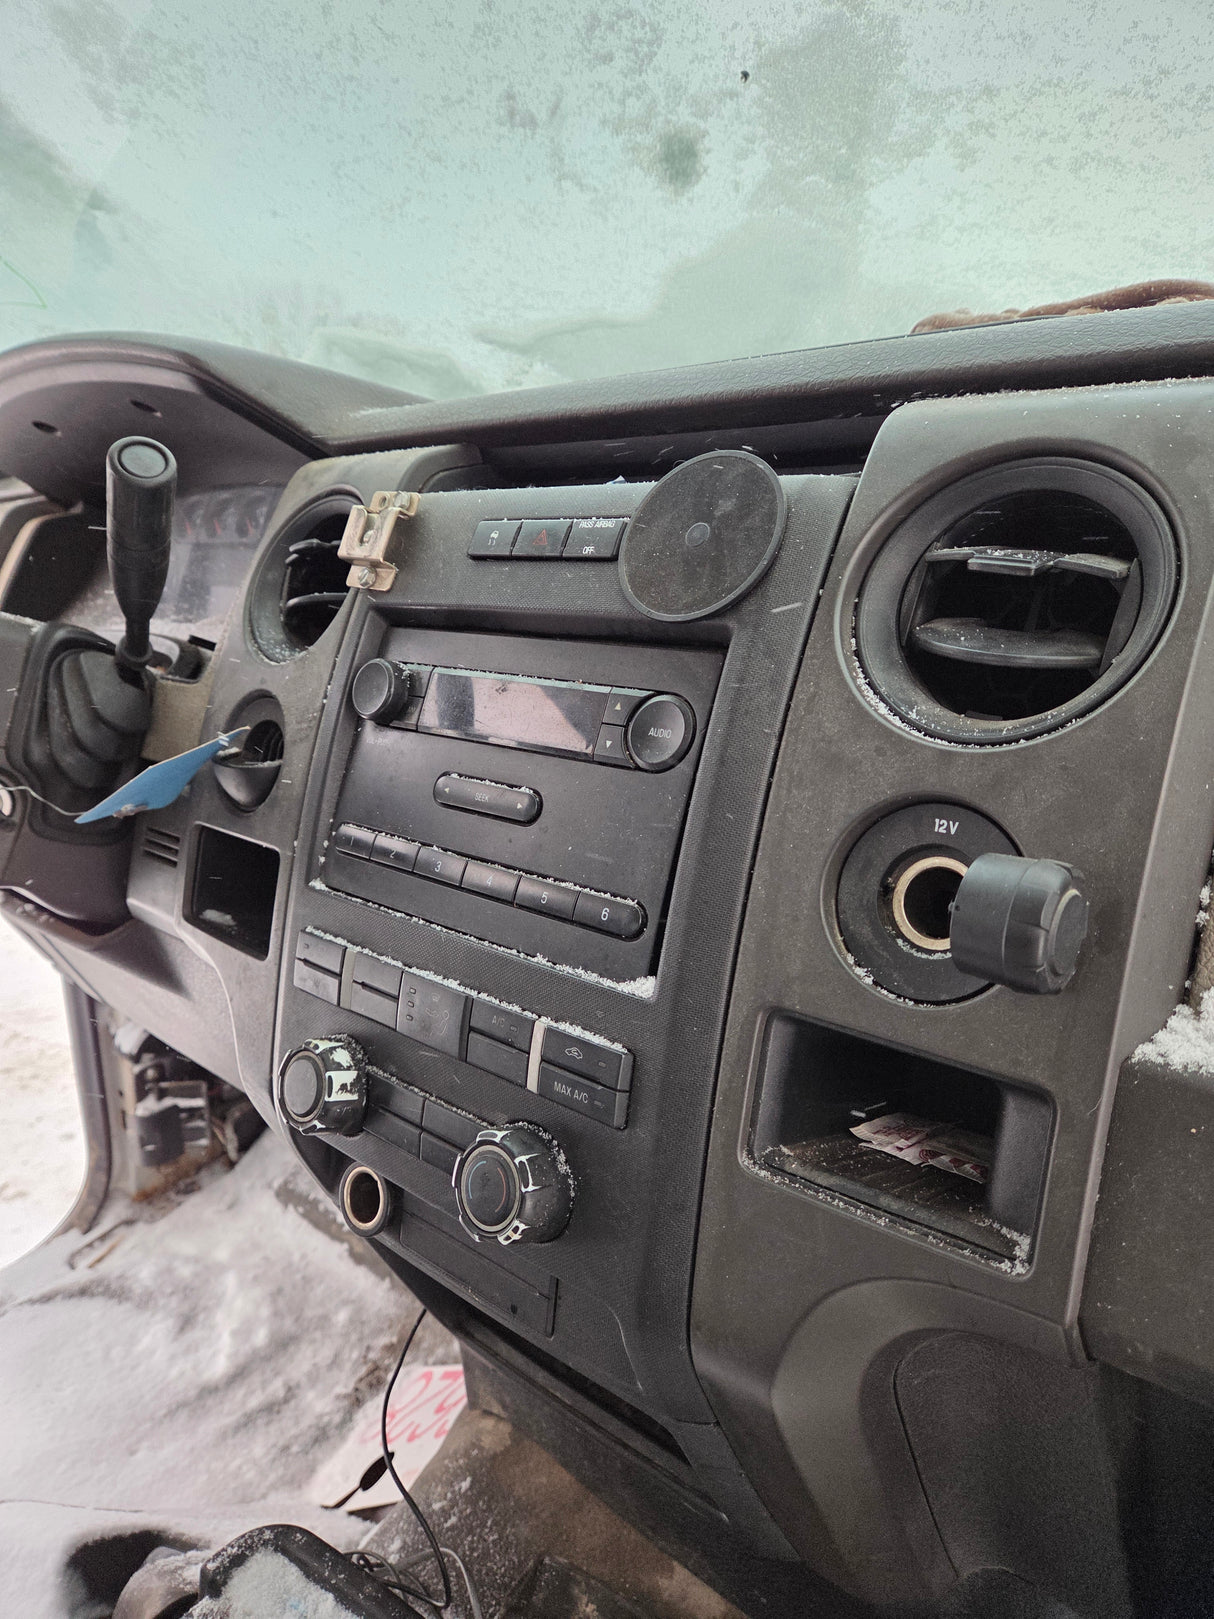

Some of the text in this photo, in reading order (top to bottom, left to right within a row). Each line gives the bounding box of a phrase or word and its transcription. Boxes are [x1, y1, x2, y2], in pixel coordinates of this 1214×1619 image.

[579, 520, 616, 528] PASS AIRBAG
[582, 545, 595, 555] OFF
[648, 726, 673, 740] AUDIO
[474, 792, 489, 803] SEEK
[933, 818, 960, 835] 12V
[389, 849, 397, 859] 2
[434, 860, 442, 873] 3
[486, 874, 494, 887] 4
[540, 891, 548, 904] 5
[600, 907, 610, 921] 6
[491, 1015, 506, 1029] A/C
[553, 1081, 589, 1105] MAX A/C
